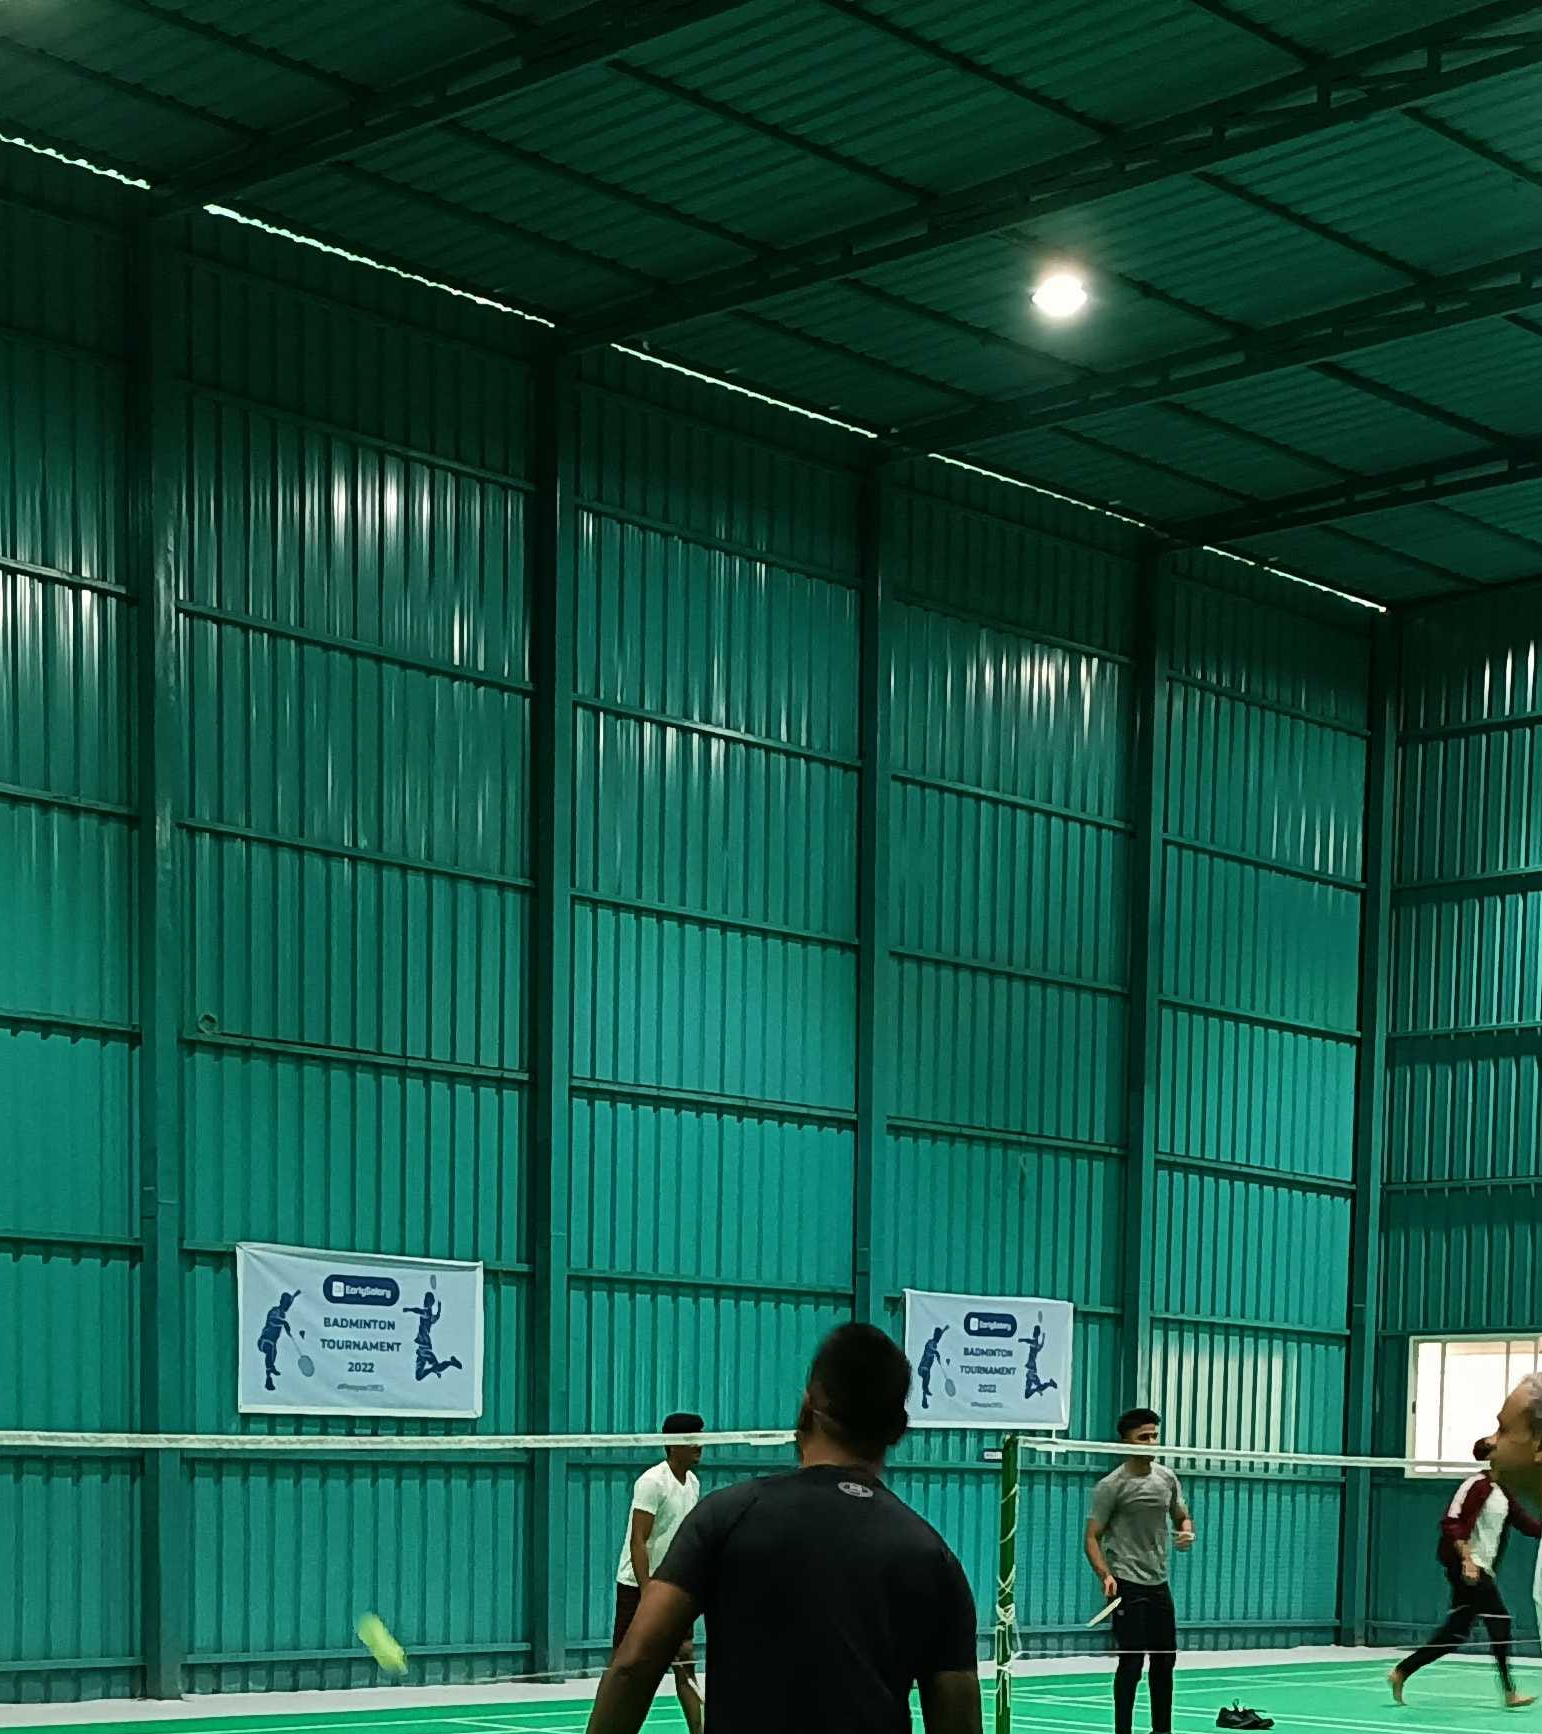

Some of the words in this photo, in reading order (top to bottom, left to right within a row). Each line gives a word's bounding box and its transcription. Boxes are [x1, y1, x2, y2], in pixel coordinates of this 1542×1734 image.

[323, 1317, 396, 1331] BADMINTON
[320, 1338, 402, 1353] TOURNAMENT
[963, 1347, 1013, 1358] BADMINTON
[347, 1362, 375, 1373] 2022
[960, 1365, 1017, 1376] TOURNAMENT
